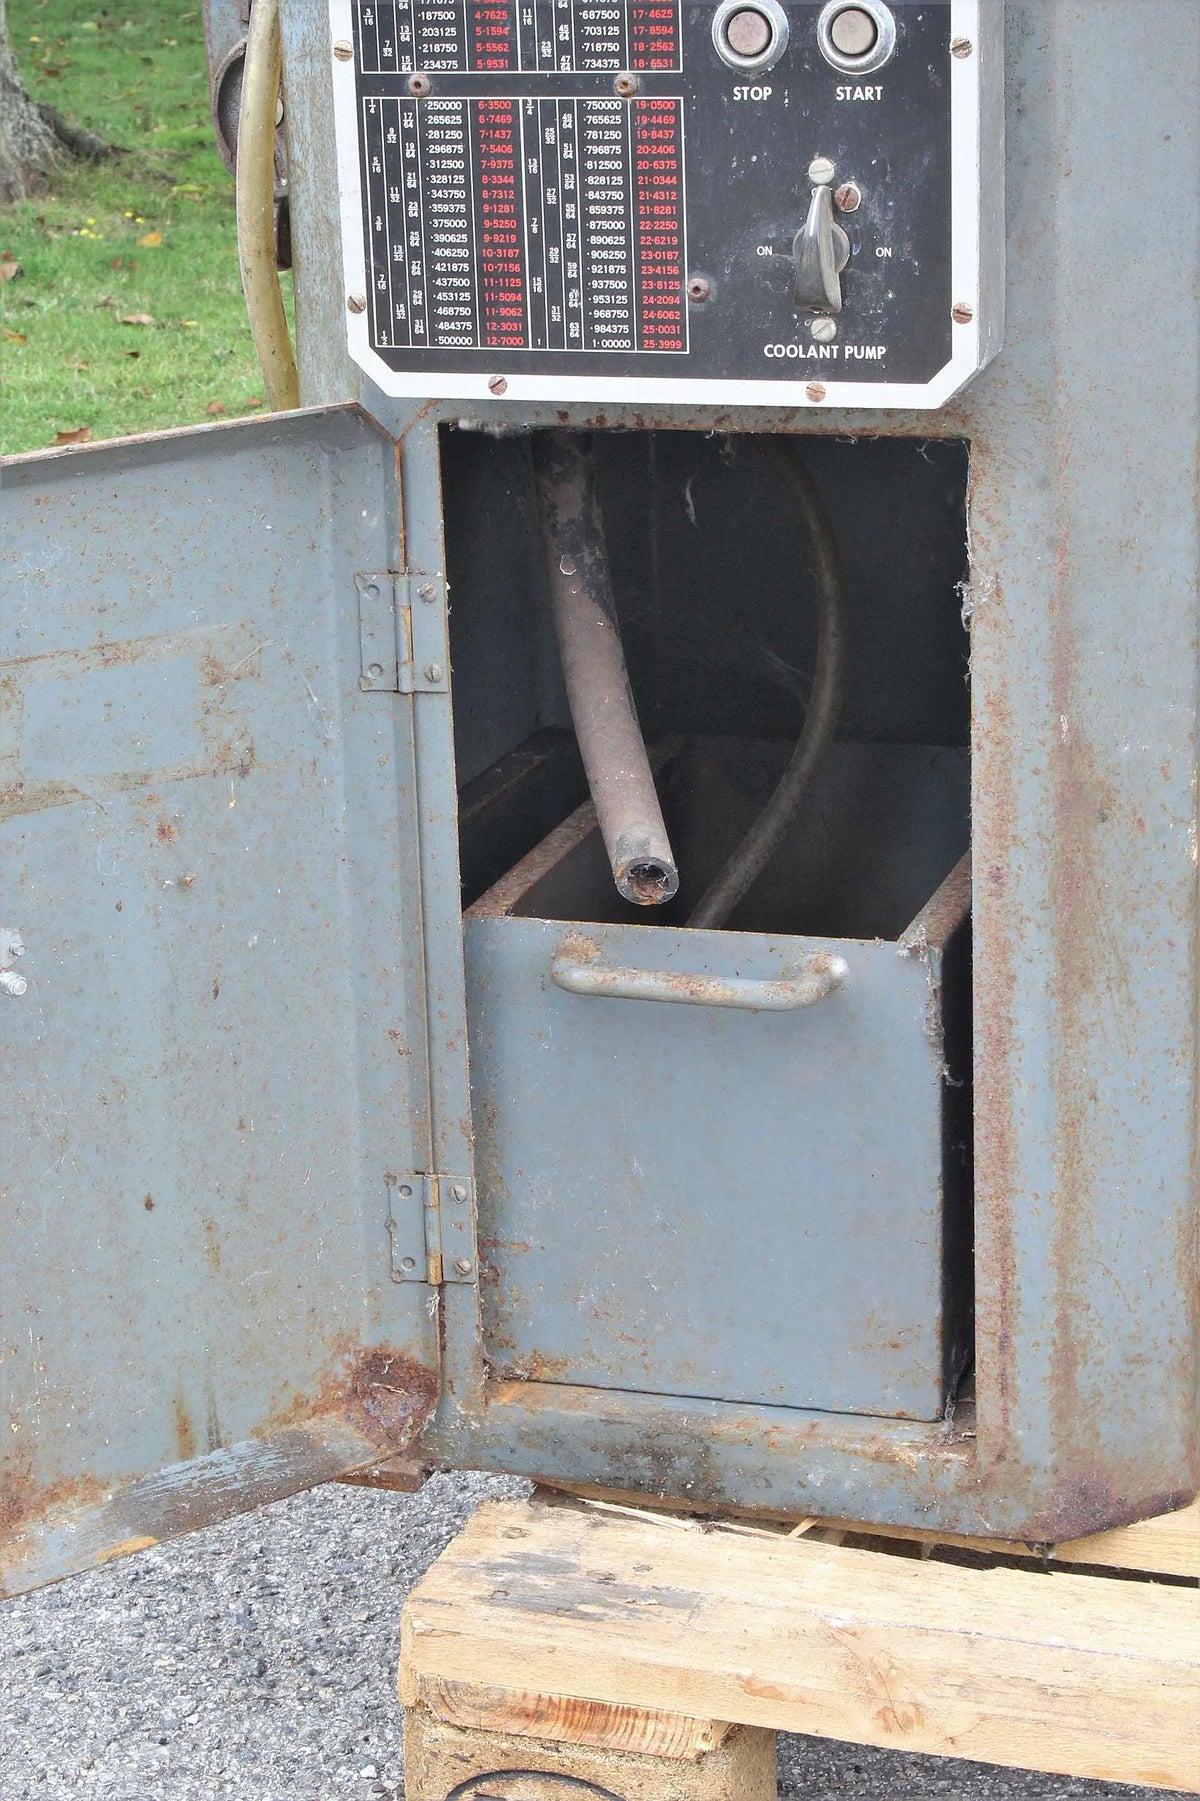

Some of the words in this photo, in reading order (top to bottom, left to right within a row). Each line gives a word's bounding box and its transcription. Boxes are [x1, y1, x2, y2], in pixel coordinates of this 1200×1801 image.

[733, 87, 772, 100] STOP
[835, 86, 883, 100] START
[757, 246, 772, 256] ON
[876, 248, 892, 257] ON
[764, 344, 839, 359] COOLANT
[845, 346, 887, 359] PUMP
